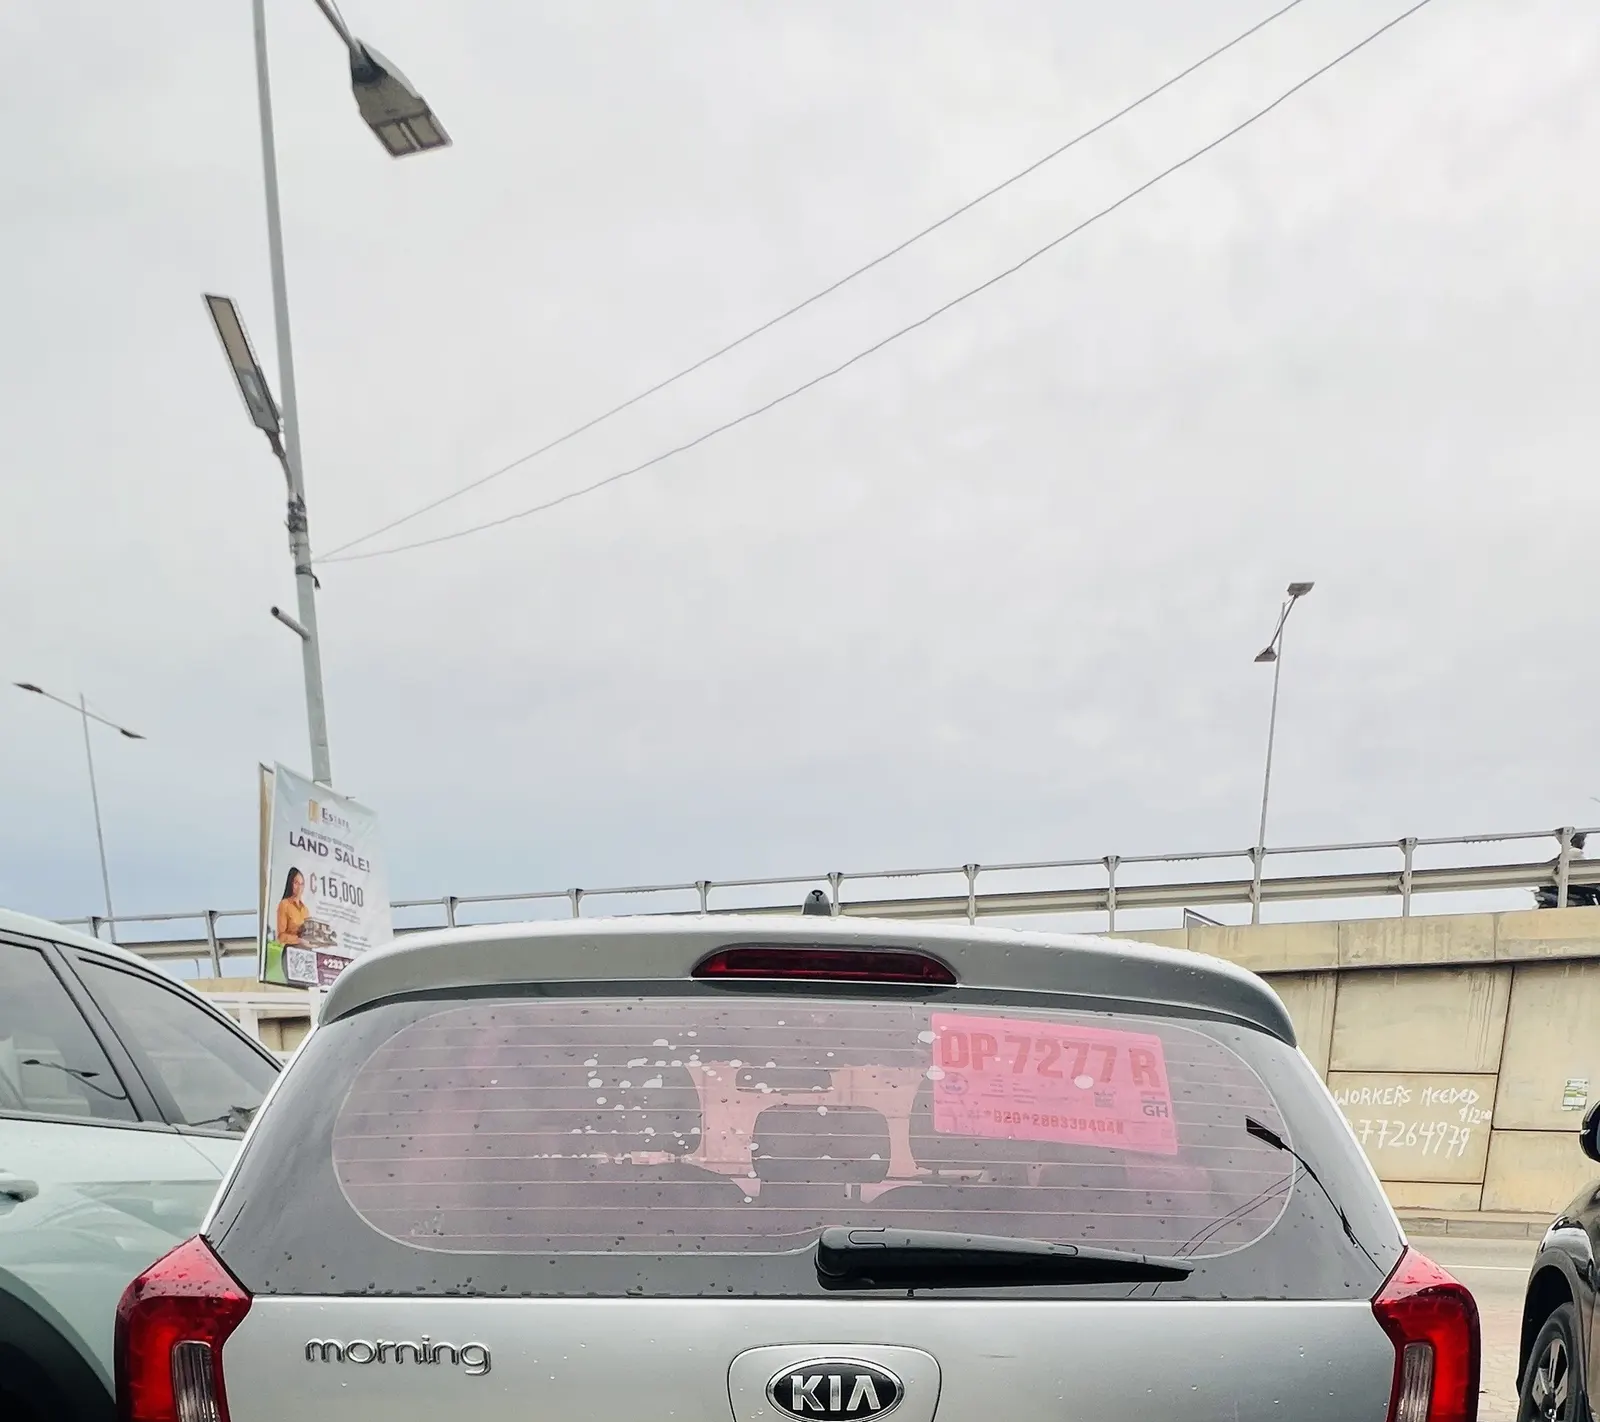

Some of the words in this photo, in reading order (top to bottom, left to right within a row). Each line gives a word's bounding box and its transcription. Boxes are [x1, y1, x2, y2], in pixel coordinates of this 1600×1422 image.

[289, 831, 329, 858] LAND
[334, 847, 371, 874] SALE!
[940, 1028, 998, 1071] DP
[1004, 1035, 1118, 1084] 7277
[1129, 1048, 1161, 1088] R
[1142, 1105, 1169, 1119] GH
[1334, 1085, 1413, 1107] WORKERS
[1420, 1086, 1480, 1107] NEEDED
[304, 1334, 492, 1376] morning
[790, 1374, 881, 1412] KIA
